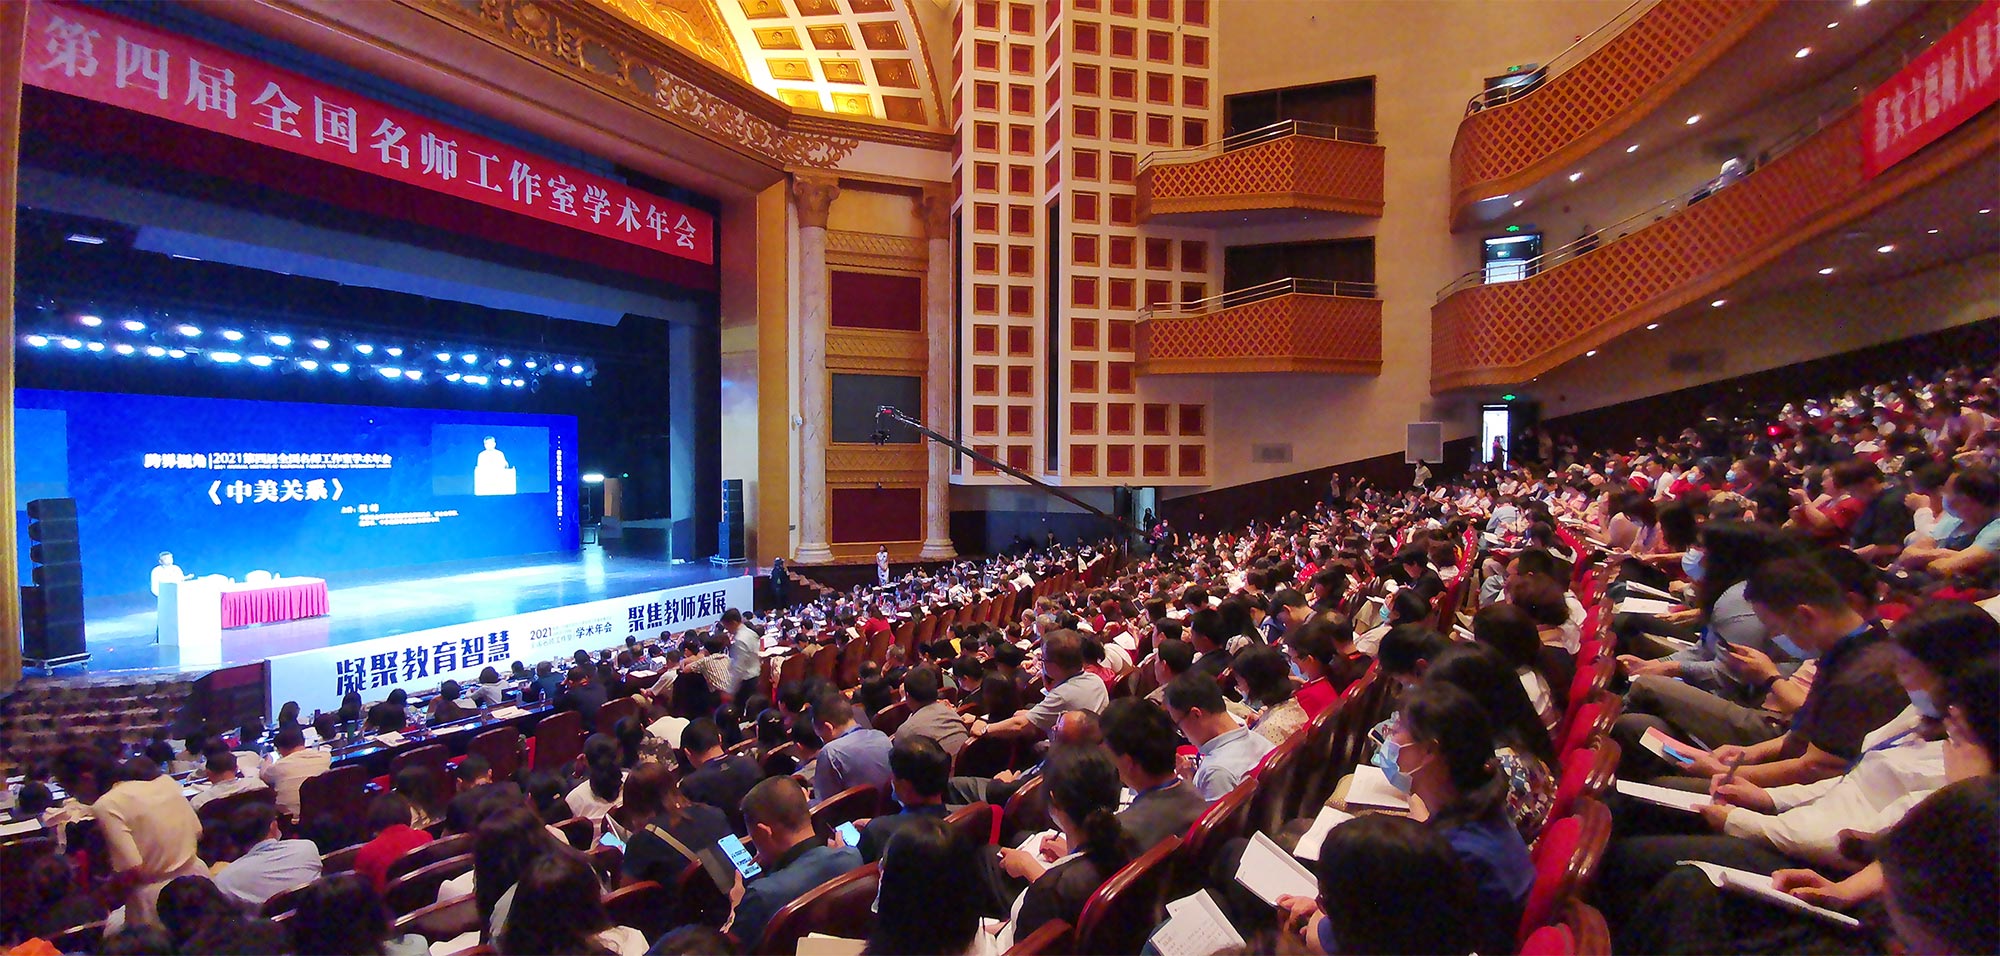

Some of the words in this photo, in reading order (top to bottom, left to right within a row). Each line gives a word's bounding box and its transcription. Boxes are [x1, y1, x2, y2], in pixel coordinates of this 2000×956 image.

[45, 16, 697, 250] 第四届全国名师工作室学术年会
[208, 478, 344, 505] 《中美关系》
[627, 589, 727, 634] 聚焦教师发展
[530, 626, 552, 640] 2021
[576, 621, 613, 639] 学术年会
[336, 629, 510, 696] 凝聚教育智慧
